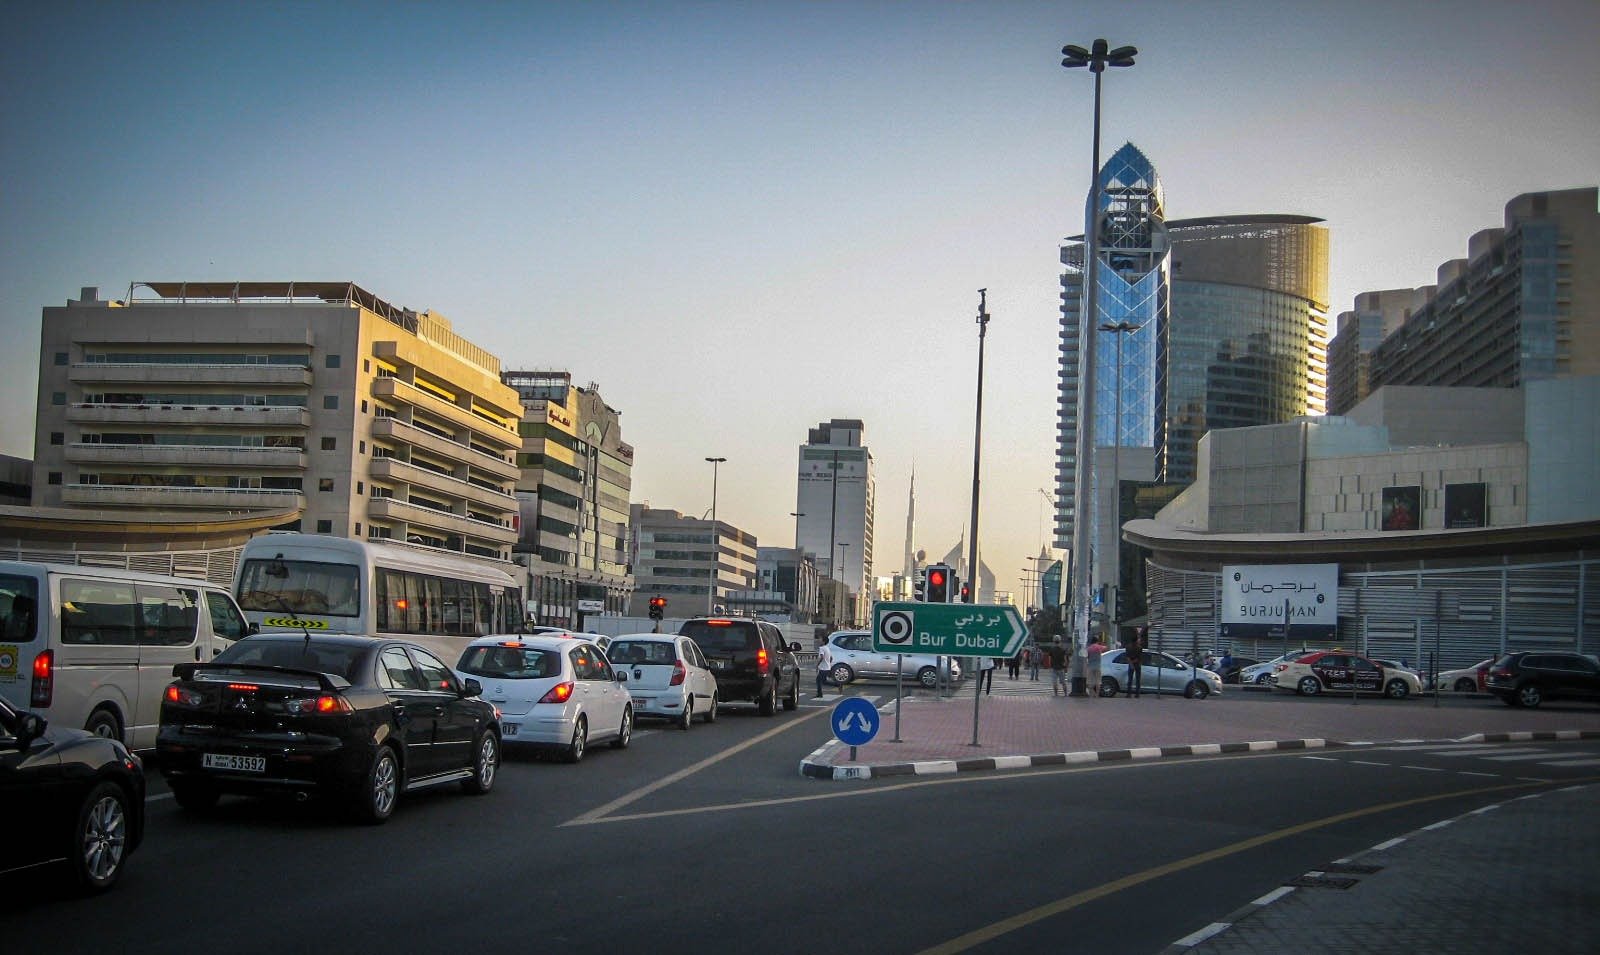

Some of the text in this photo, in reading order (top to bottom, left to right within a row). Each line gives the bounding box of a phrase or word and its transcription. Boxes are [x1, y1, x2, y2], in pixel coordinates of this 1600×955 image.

[1241, 581, 1317, 593] برجمان
[1240, 605, 1316, 617] BURJUMAN
[919, 632, 1000, 648] Bur Dubai
[206, 754, 212, 766] N
[231, 757, 264, 770] 53592
